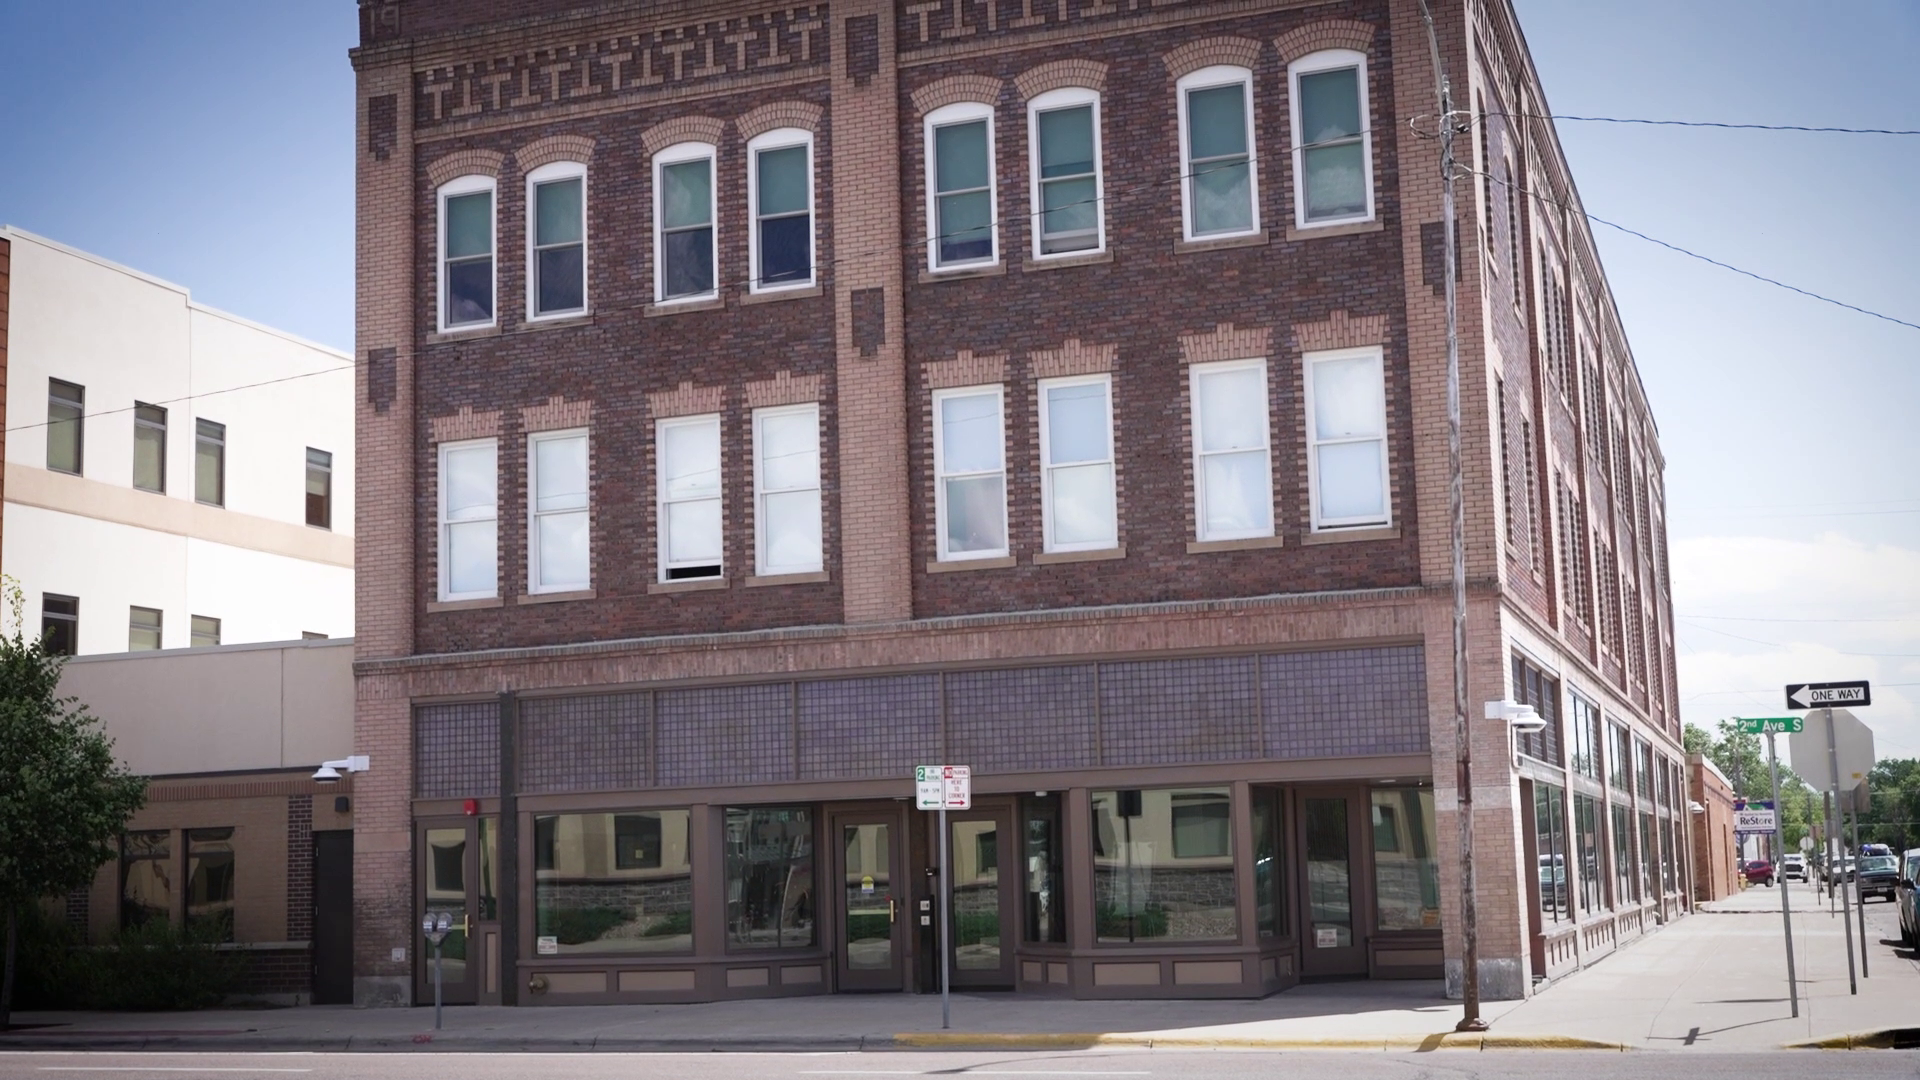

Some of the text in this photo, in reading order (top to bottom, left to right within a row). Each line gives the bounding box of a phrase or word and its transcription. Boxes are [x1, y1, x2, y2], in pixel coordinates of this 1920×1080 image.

[1811, 688, 1861, 701] ONE WAY
[1739, 718, 1802, 732] 2nd Ave S
[918, 769, 924, 780] 2
[1740, 816, 1773, 825] ReStore
